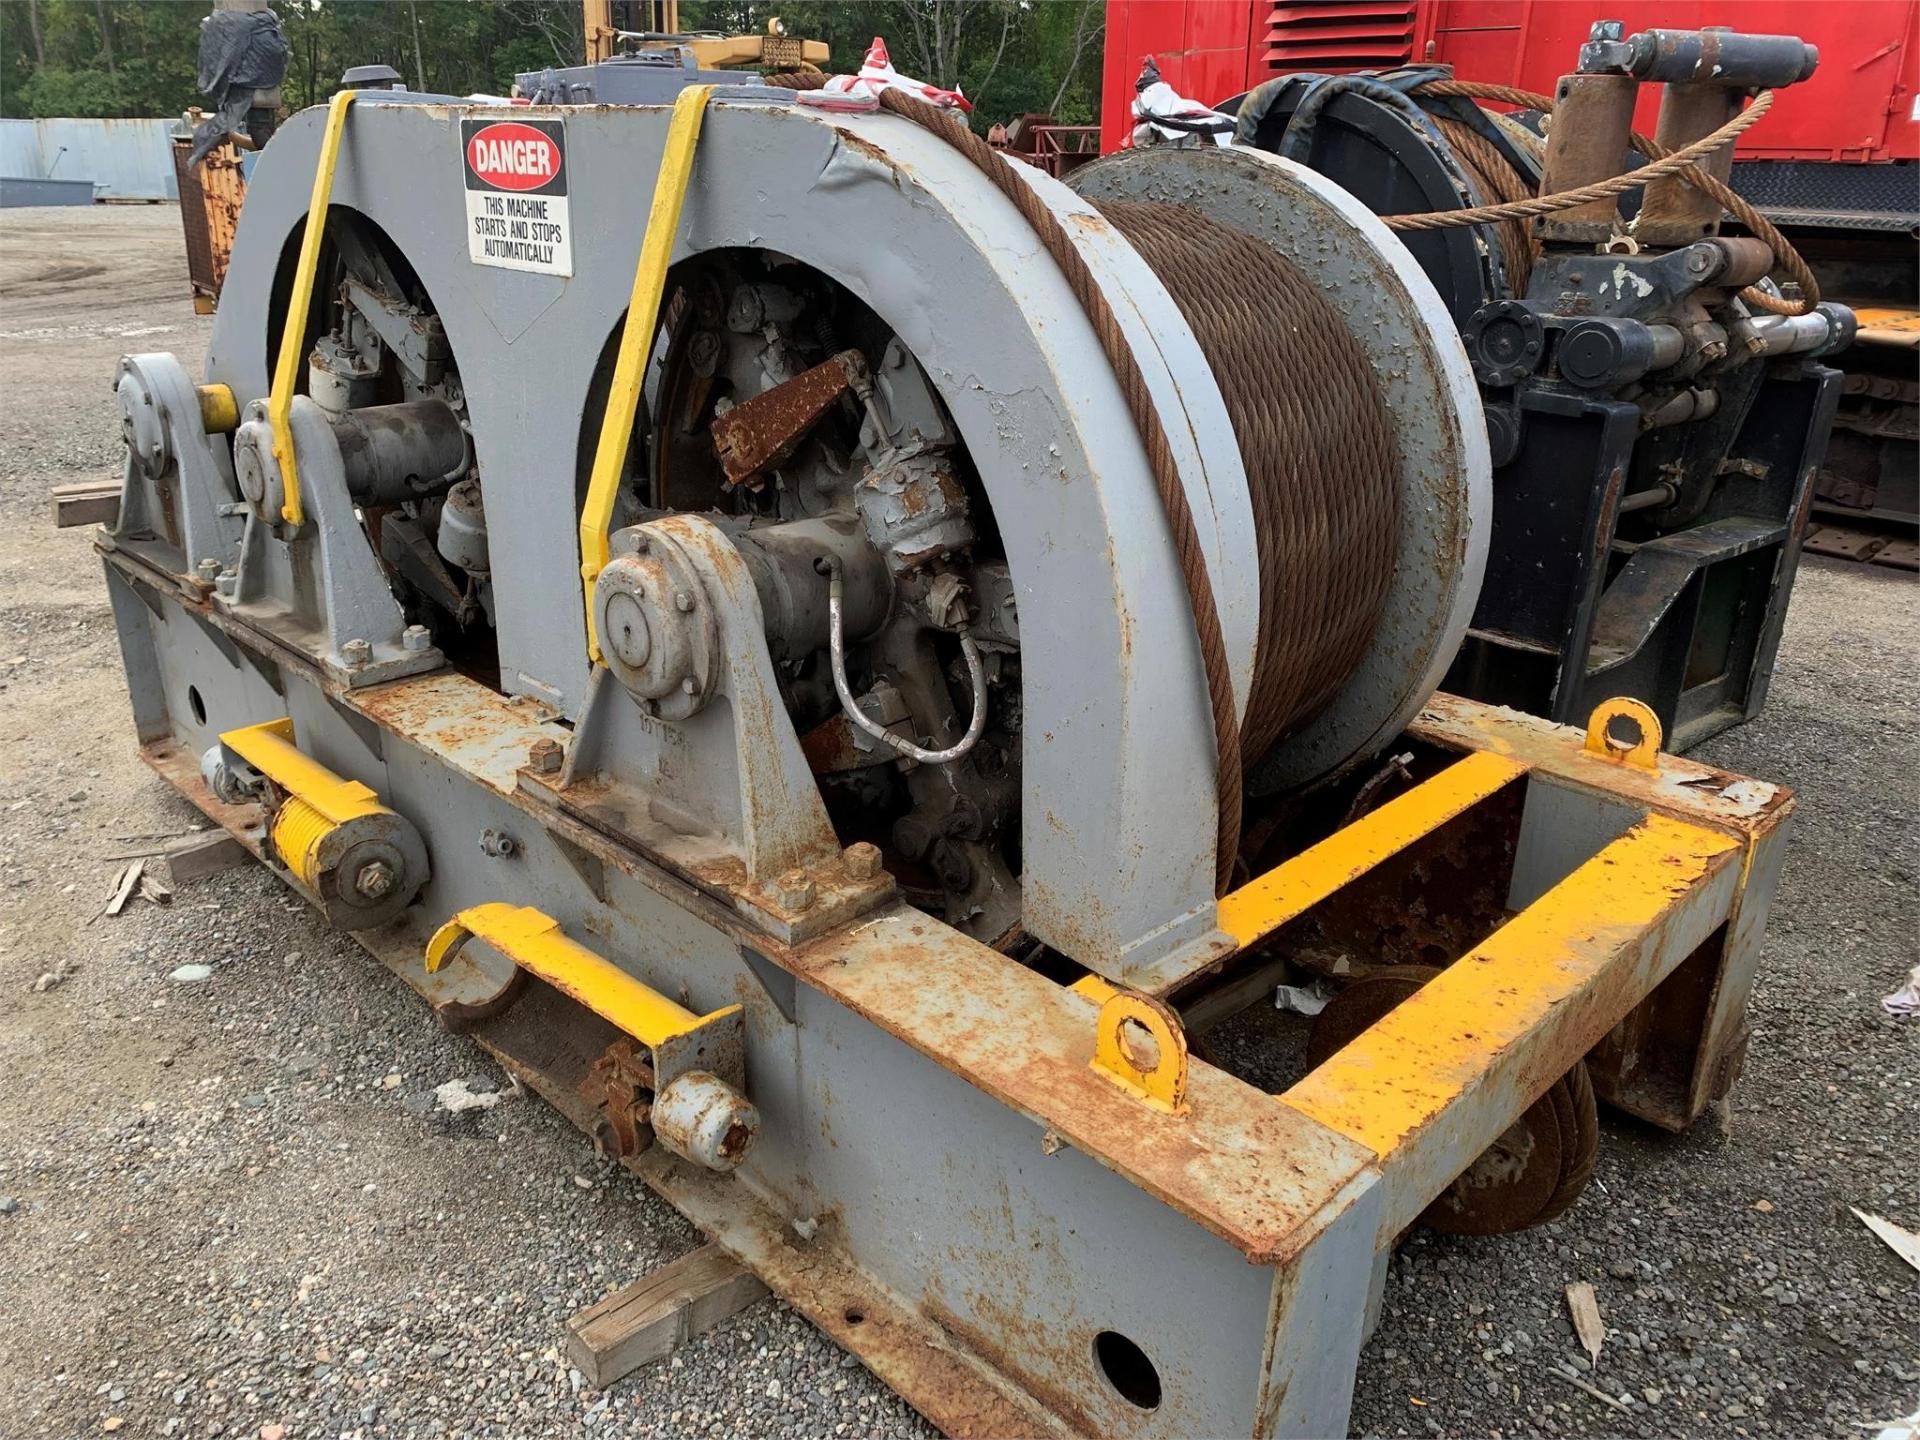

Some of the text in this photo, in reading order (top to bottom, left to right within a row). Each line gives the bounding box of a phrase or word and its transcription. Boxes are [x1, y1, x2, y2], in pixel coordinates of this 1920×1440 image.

[475, 139, 551, 175] DANGER
[484, 196, 548, 220] THIS MACHINE
[475, 216, 562, 244] STARTS AND STOPS
[485, 238, 553, 264] AUTOMATICALLY
